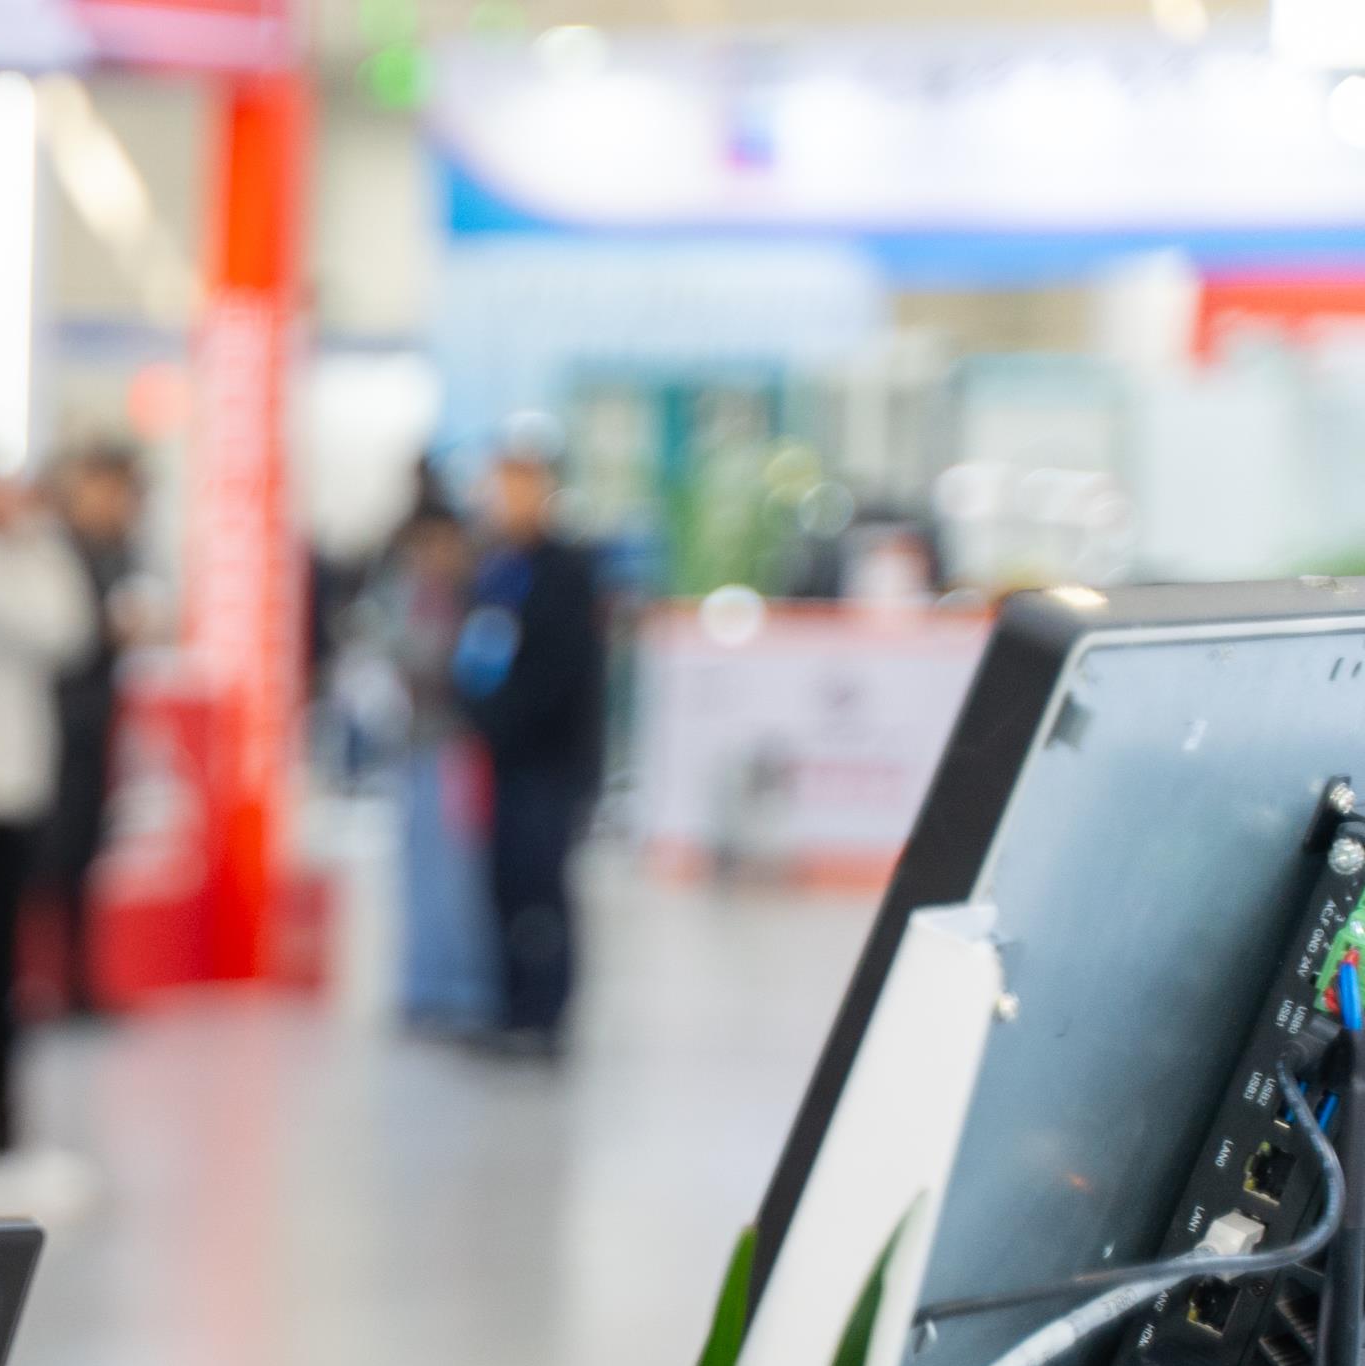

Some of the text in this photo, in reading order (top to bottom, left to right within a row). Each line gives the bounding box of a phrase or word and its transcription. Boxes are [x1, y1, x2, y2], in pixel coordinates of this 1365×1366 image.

[1306, 928, 1325, 953] GND
[1275, 999, 1295, 1027] USB1
[1243, 1071, 1263, 1100] USB3
[1214, 1139, 1234, 1167] LAN0
[1187, 1205, 1205, 1233] LAN1
[1153, 1287, 1172, 1312] AN2
